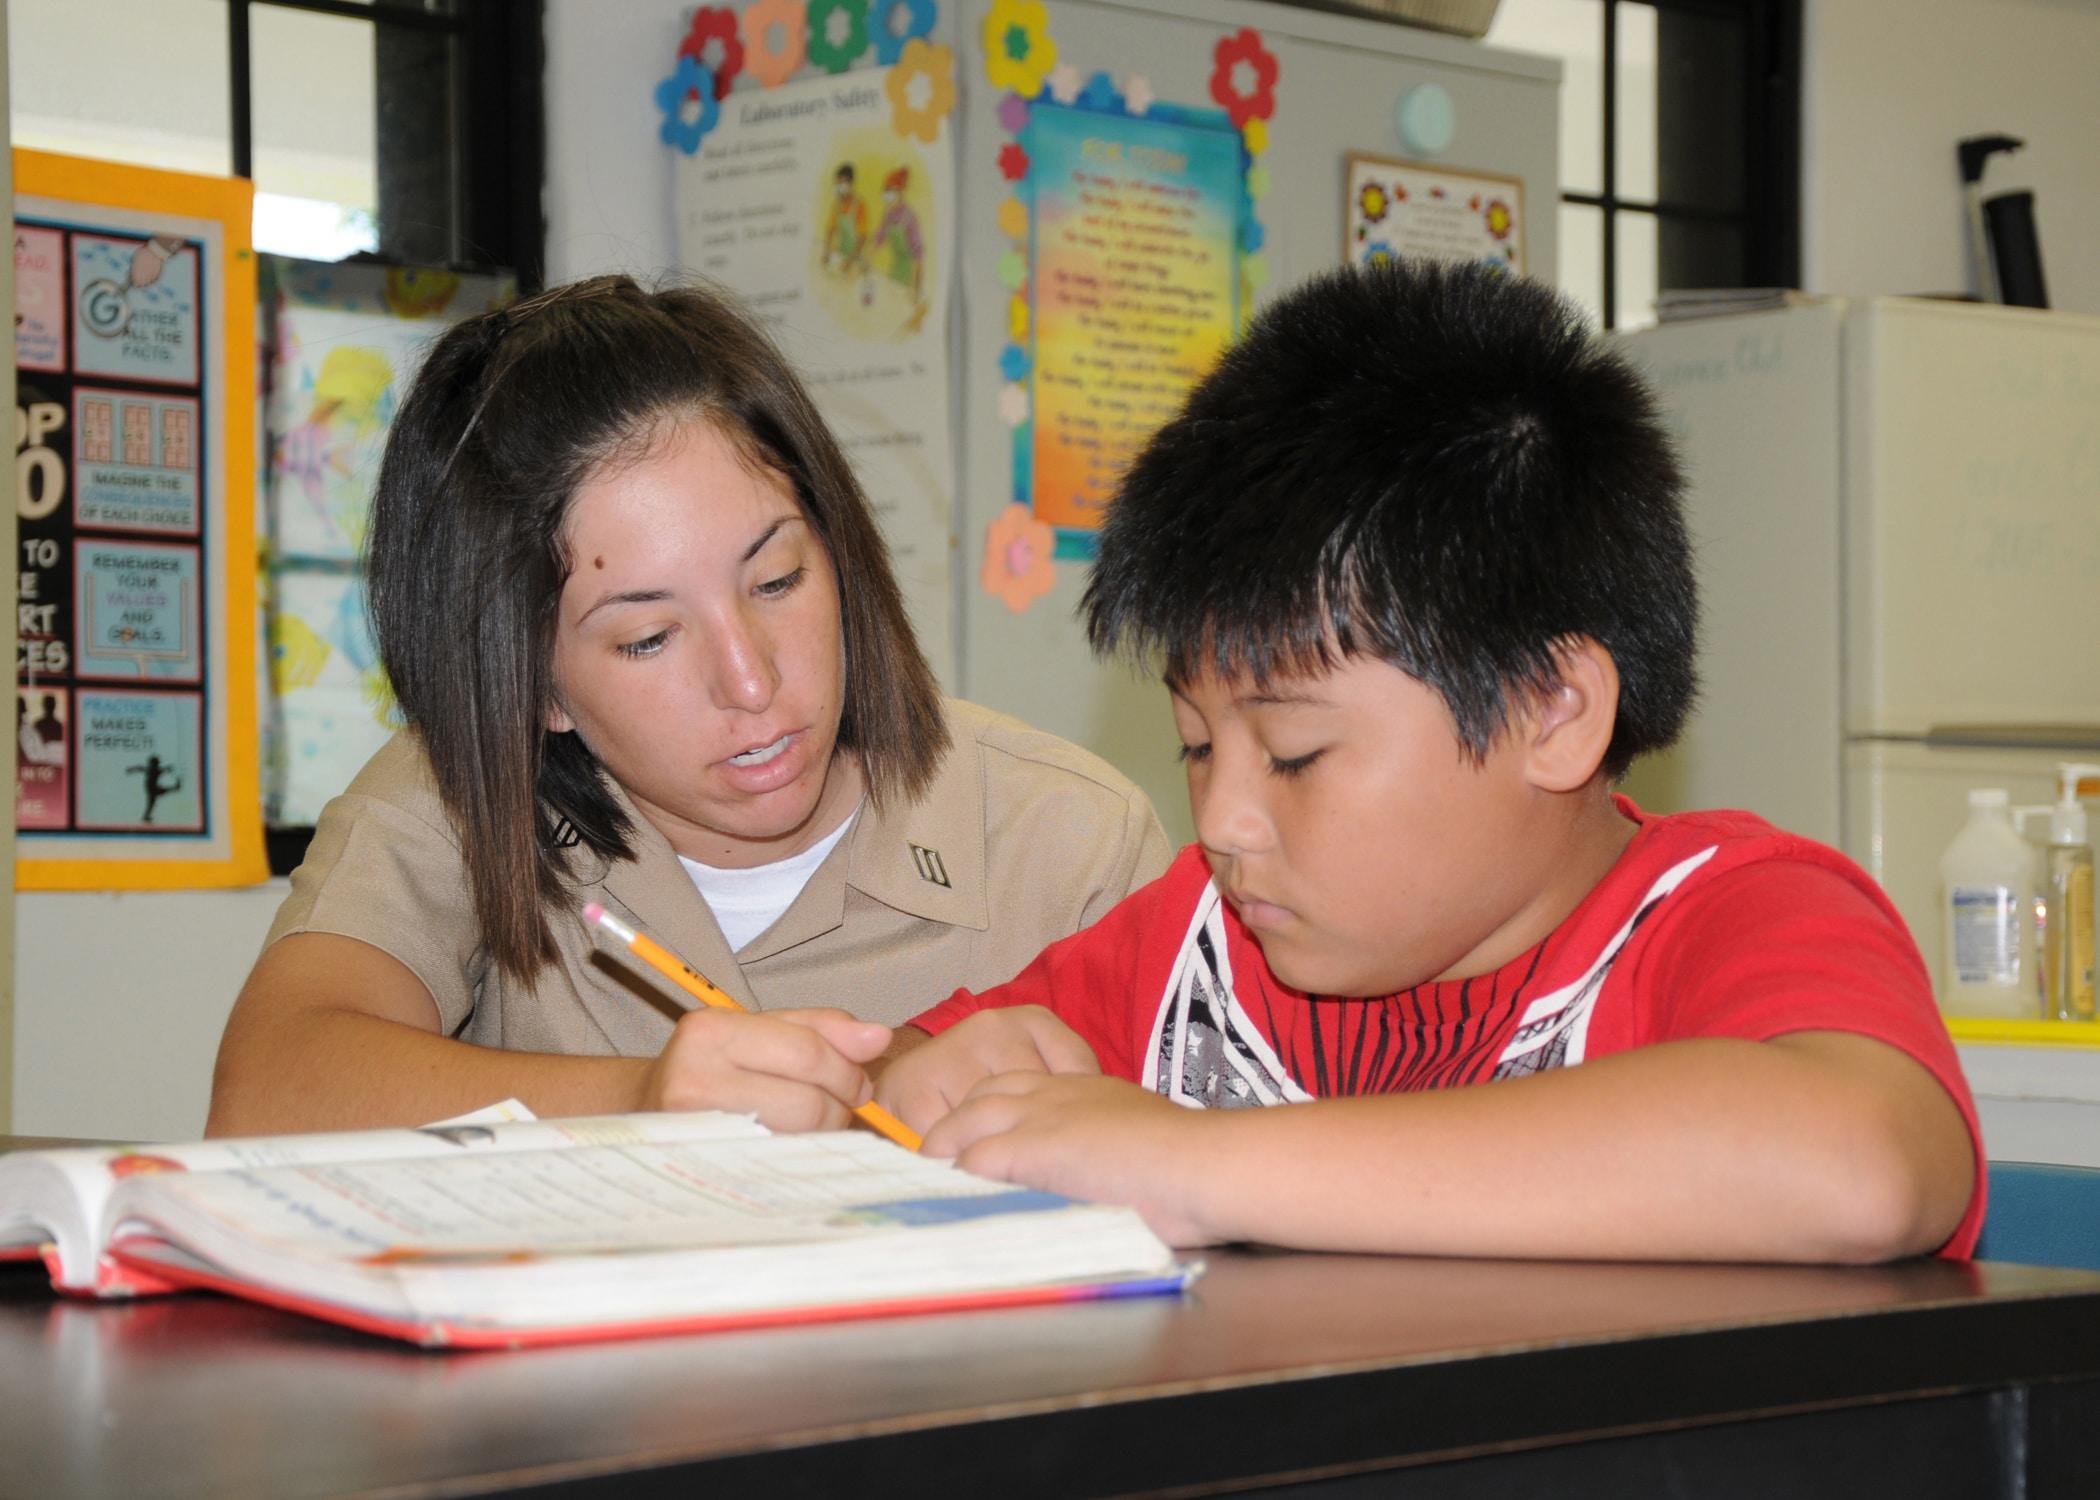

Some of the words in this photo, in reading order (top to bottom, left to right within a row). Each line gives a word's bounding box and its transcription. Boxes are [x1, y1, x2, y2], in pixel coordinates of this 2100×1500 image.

[737, 99, 826, 128] Laboratory
[833, 86, 881, 110] Safety
[153, 328, 182, 344] THE
[93, 472, 152, 488] IMAGINE
[155, 474, 183, 490] THE
[101, 507, 138, 522] EACH
[141, 508, 192, 526] CHOICE
[23, 538, 60, 568] TO
[92, 553, 181, 573] REMEMBER
[115, 574, 160, 589] YOUR
[105, 591, 169, 607] VALUES
[120, 609, 154, 624] AND
[92, 716, 147, 731] MAKES
